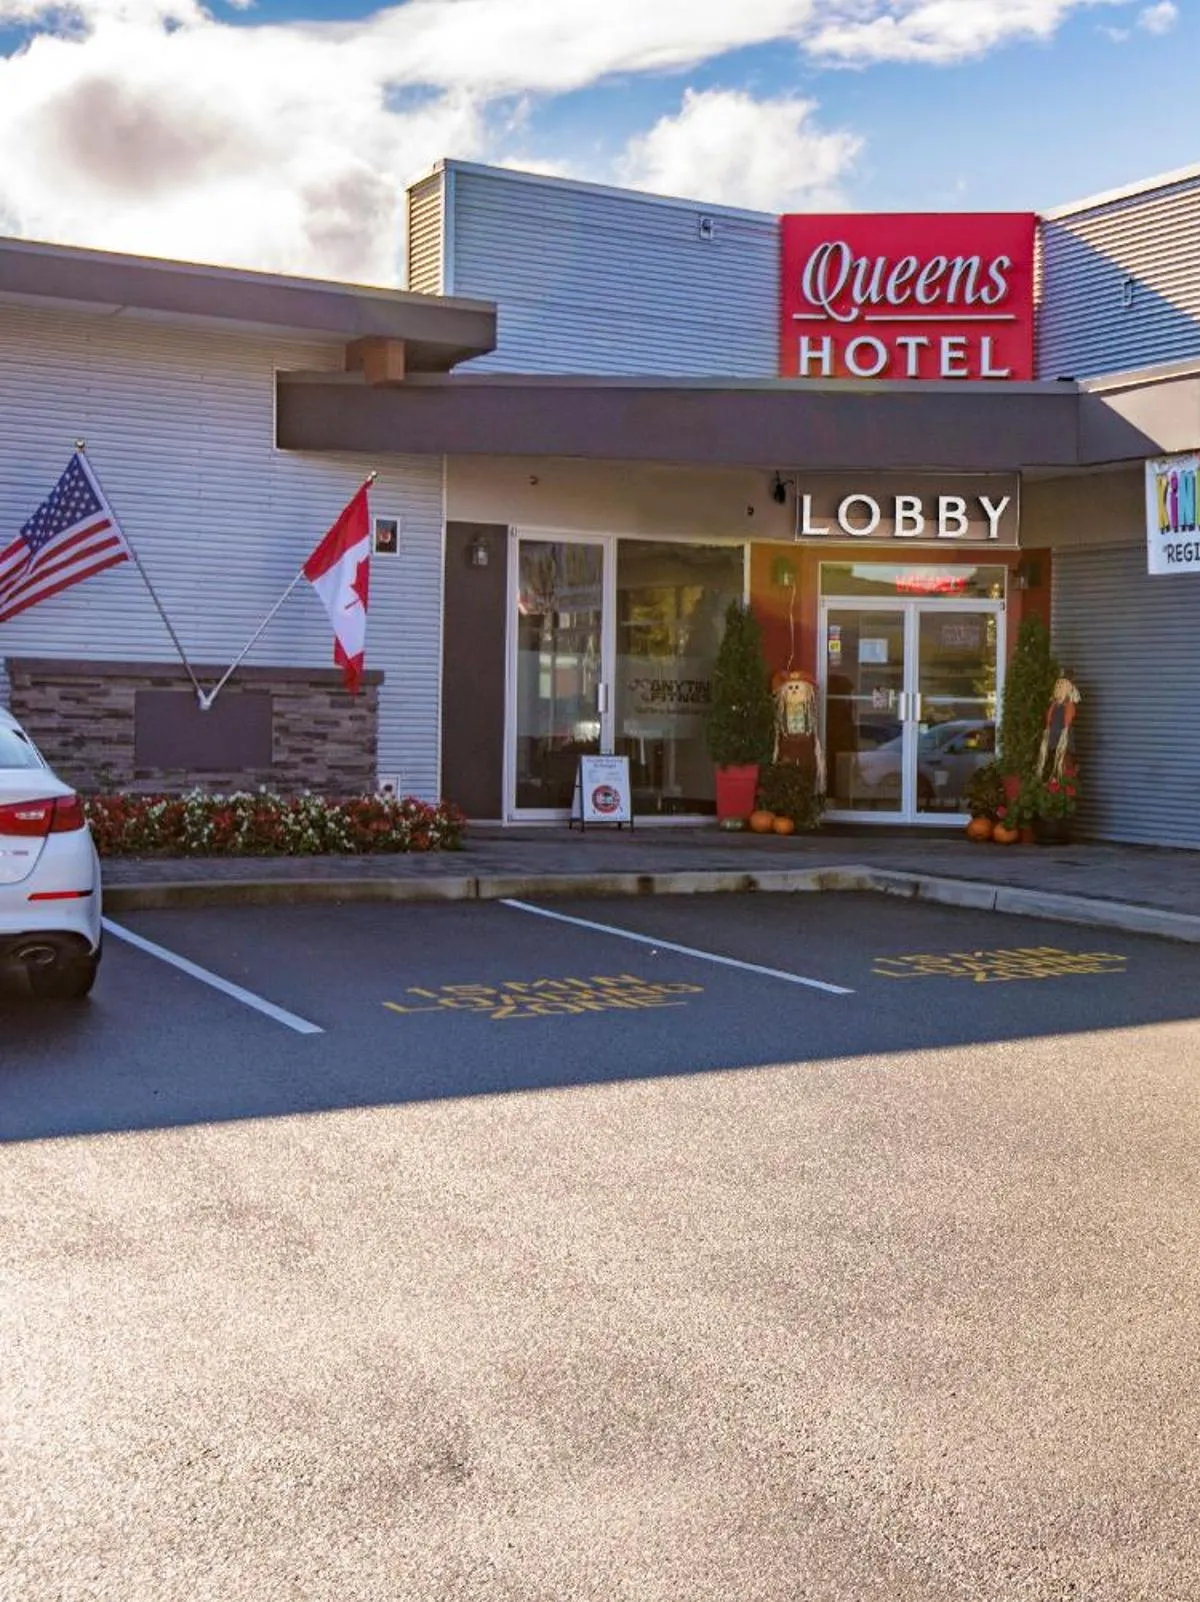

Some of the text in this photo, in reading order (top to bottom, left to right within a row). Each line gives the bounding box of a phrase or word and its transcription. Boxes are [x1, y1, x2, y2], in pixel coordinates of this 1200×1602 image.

[801, 240, 1012, 322] Queens
[798, 335, 1012, 377] HOTEL
[801, 493, 1011, 539] LOBBY
